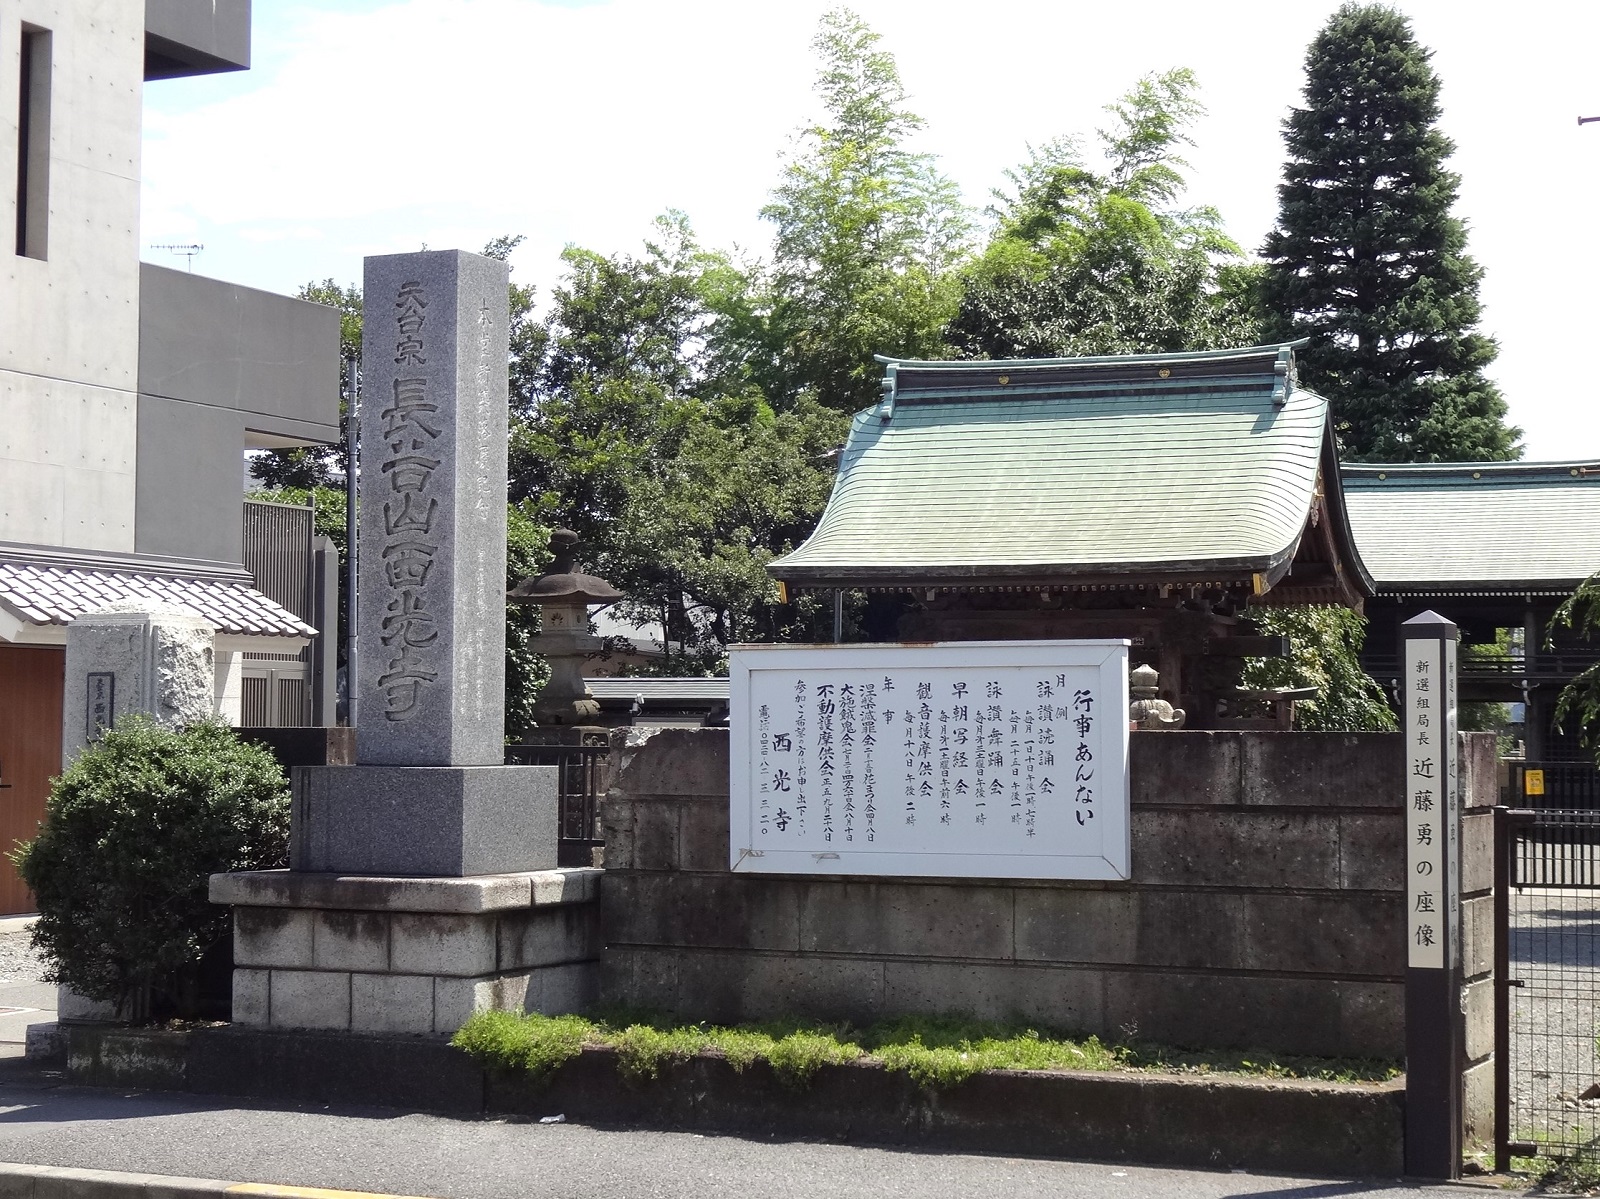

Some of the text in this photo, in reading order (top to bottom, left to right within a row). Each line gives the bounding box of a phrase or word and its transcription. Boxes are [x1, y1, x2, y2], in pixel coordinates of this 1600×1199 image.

[394, 280, 430, 366] 天台宗
[772, 732, 793, 832] 西光寺
[915, 682, 935, 798] 観音護摩供会
[951, 682, 970, 796] 早朝写経会
[1072, 689, 1094, 826] 行事あんない
[1412, 660, 1436, 947] 新選組局長 近藤勇の座像
